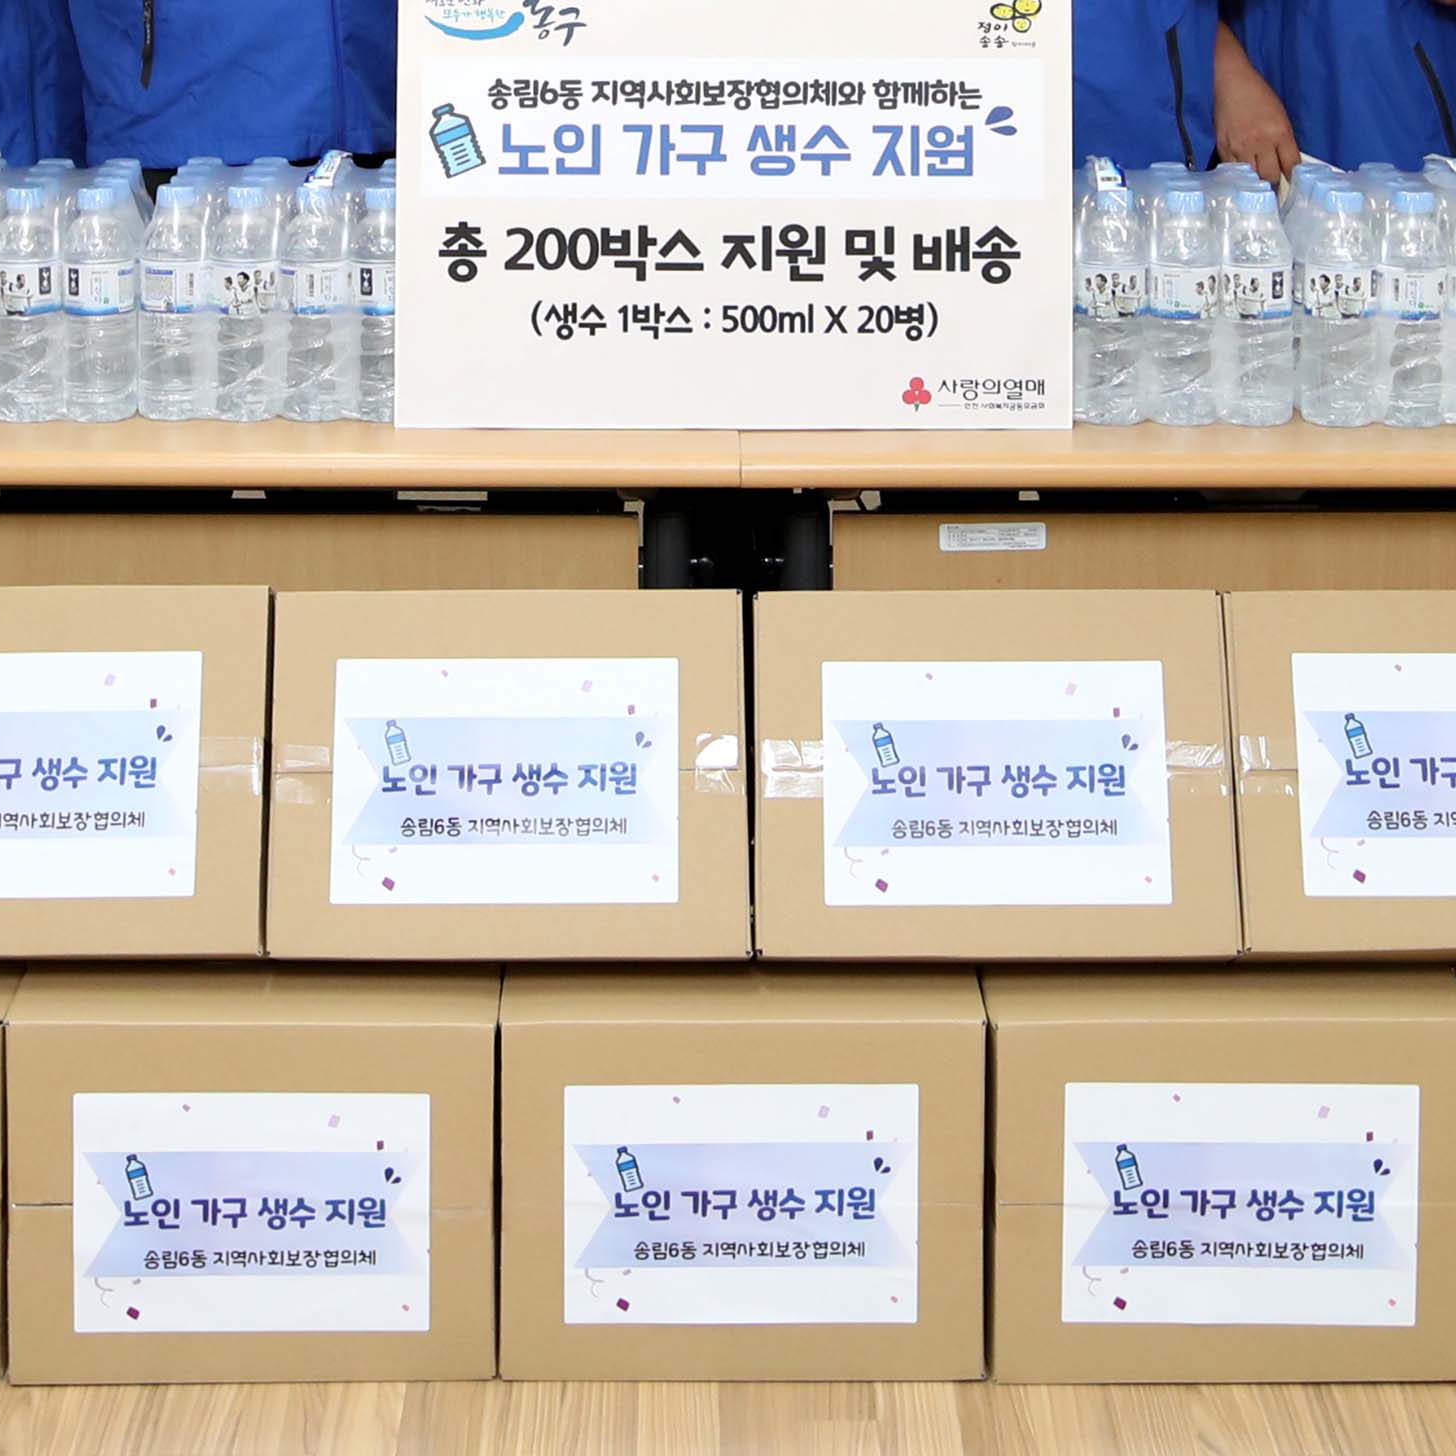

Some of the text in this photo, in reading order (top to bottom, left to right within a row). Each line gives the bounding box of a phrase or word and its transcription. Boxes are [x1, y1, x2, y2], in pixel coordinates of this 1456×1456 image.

[487, 79, 982, 111] 송림6동 지역사회보장협의체와 함께하는
[498, 124, 974, 177] 노인 가구 생수 지원
[439, 222, 1021, 284] 총 200박스 지원 및 배송
[531, 300, 606, 341] (생수
[618, 302, 693, 340] 1박스
[722, 303, 813, 334] 500ml
[825, 305, 847, 334] X
[858, 300, 939, 342] 20병)
[938, 378, 1045, 401] 사랑의열매
[32, 757, 87, 790] 생수
[98, 756, 156, 789] 지원
[382, 763, 636, 797] 노인 가구 생수 지원
[871, 763, 1125, 798] 노인 가구 생수 지원
[1345, 758, 1400, 789] 노인
[401, 817, 626, 837] 송림6동 지역사회보장협의체
[892, 819, 1117, 839] 송림6동 지역사회보장협의체
[1367, 810, 1427, 831] 송림6동
[124, 1196, 385, 1230] 노인 가구 생수 지원
[614, 1186, 875, 1222] 노인 가구 생수 지원
[1113, 1189, 1374, 1222] 노인 가구 생수 지원
[144, 1249, 376, 1270] 송림6동 지역사회보장협의체
[634, 1241, 864, 1261] 송림6동 지역사회보장협의체
[1132, 1240, 1363, 1261] 송림6동 지역사회보장협의체
